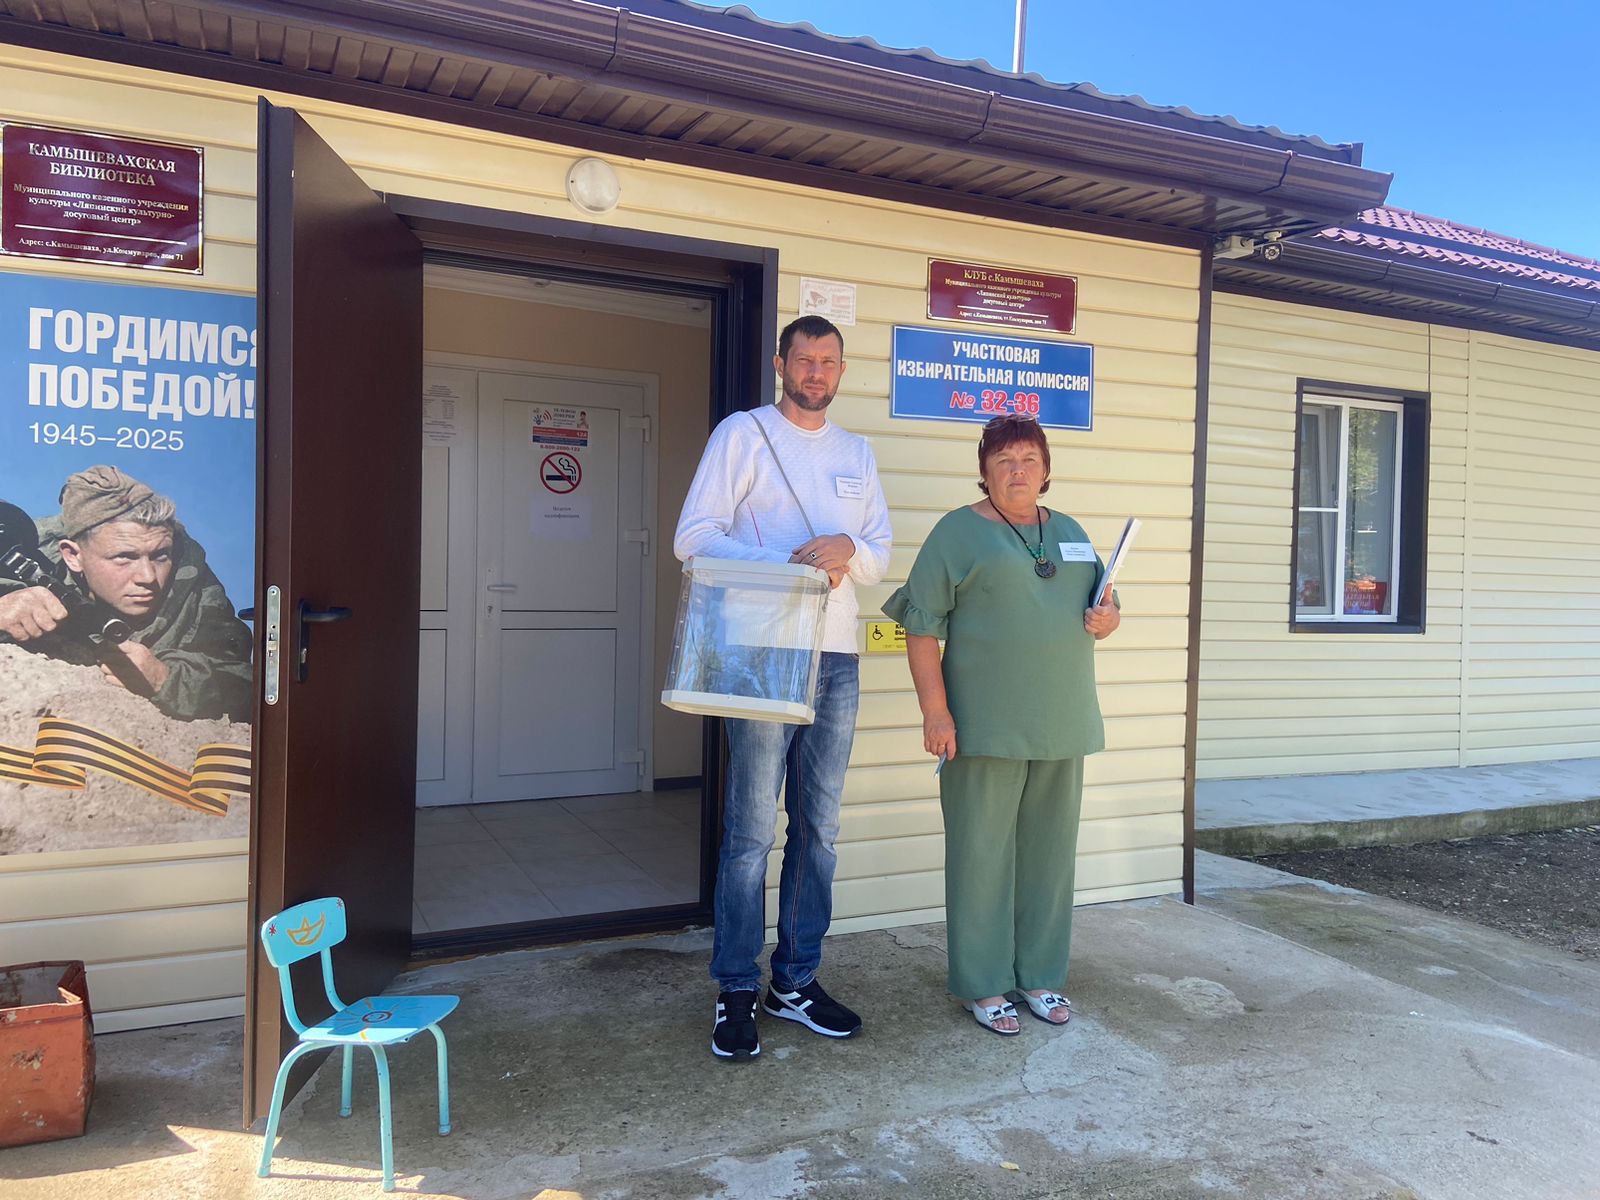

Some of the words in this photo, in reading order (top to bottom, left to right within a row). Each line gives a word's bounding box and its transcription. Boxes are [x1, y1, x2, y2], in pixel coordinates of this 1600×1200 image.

[29, 143, 176, 173] КАМЫШЕВАХСКАЯ
[50, 162, 156, 186] БИБЛИОТЕКА
[14, 183, 91, 199] Муниципального
[92, 194, 136, 205] казенного
[137, 198, 188, 212] учреждения
[28, 197, 71, 210] культуры
[128, 207, 175, 220] культурно-
[63, 211, 110, 223] досуговый
[111, 215, 141, 225] центр»
[18, 237, 44, 247] Адрес:
[964, 269, 988, 280] КЛУБ
[953, 341, 1040, 363] УЧАСТКОВАЯ
[897, 360, 1013, 384] ИЗБИРАТЕЛЬНАЯ
[1017, 370, 1089, 391] КОМИССИЯ
[28, 363, 254, 422] ПОБЕДОЙ!
[949, 391, 976, 408] №
[981, 389, 1040, 414] 32-36
